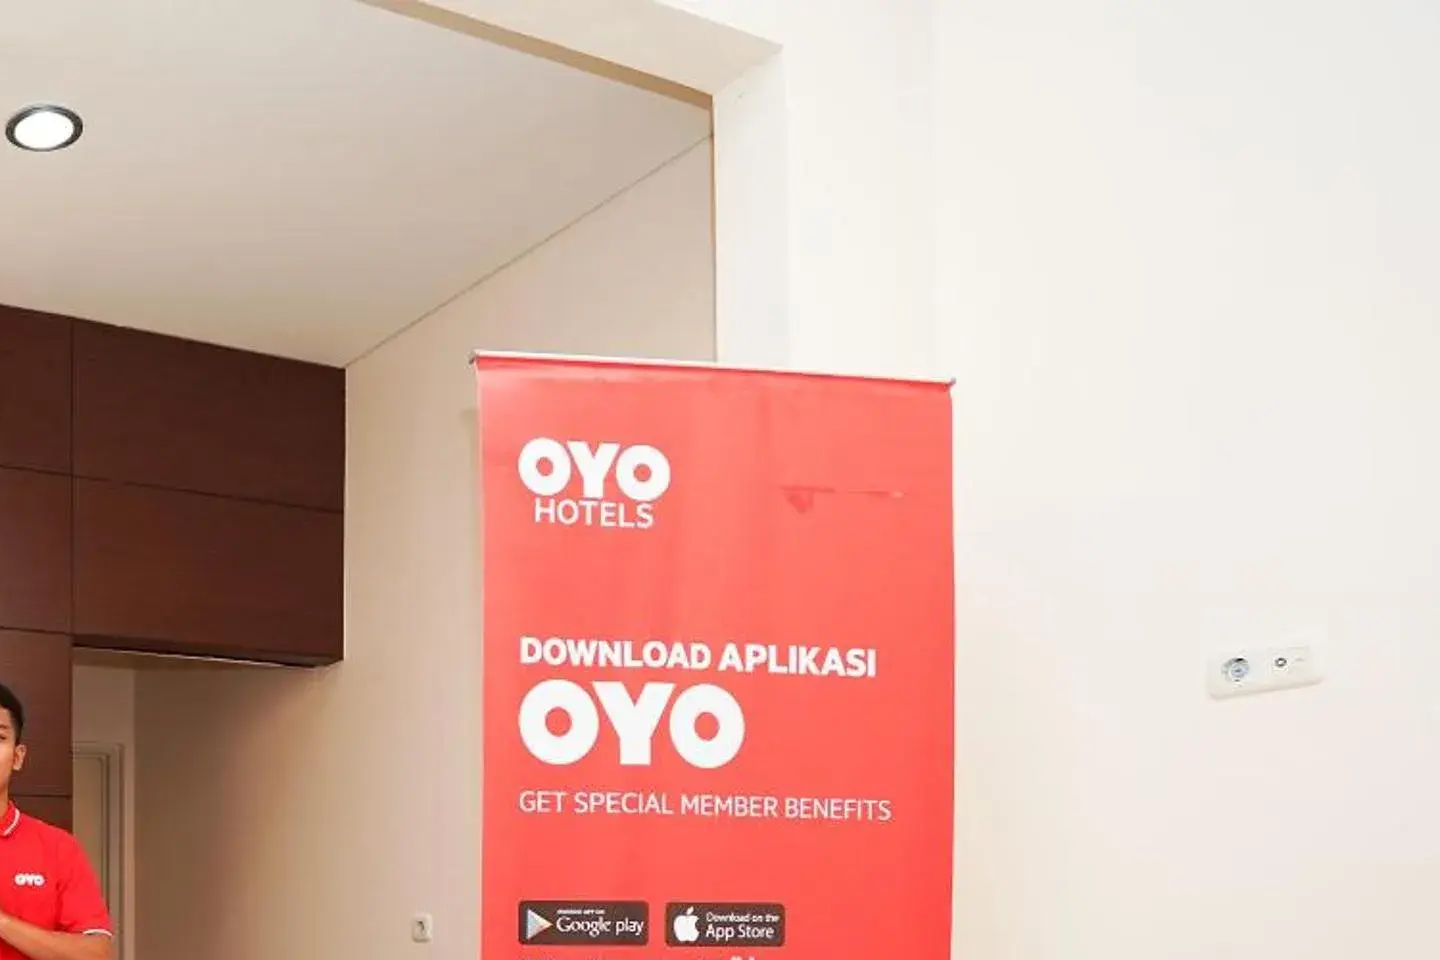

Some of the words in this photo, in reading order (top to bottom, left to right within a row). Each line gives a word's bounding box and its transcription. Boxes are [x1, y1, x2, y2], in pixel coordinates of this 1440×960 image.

[517, 437, 671, 502] OYO
[534, 499, 655, 529] HOTELS
[519, 636, 712, 671] DOWNLOAD
[718, 643, 878, 678] APLIKASI
[517, 678, 747, 769] OYO
[518, 790, 567, 814] GET
[573, 791, 674, 816] SPECIAL
[680, 794, 778, 819] MEMBER
[784, 797, 893, 822] BENEFITS
[14, 872, 46, 887] OYO
[556, 914, 612, 938] Google
[615, 916, 645, 937] play
[706, 911, 751, 923] Download
[752, 914, 763, 923] on
[765, 913, 780, 923] the
[705, 923, 735, 942] App
[737, 923, 775, 940] Store
